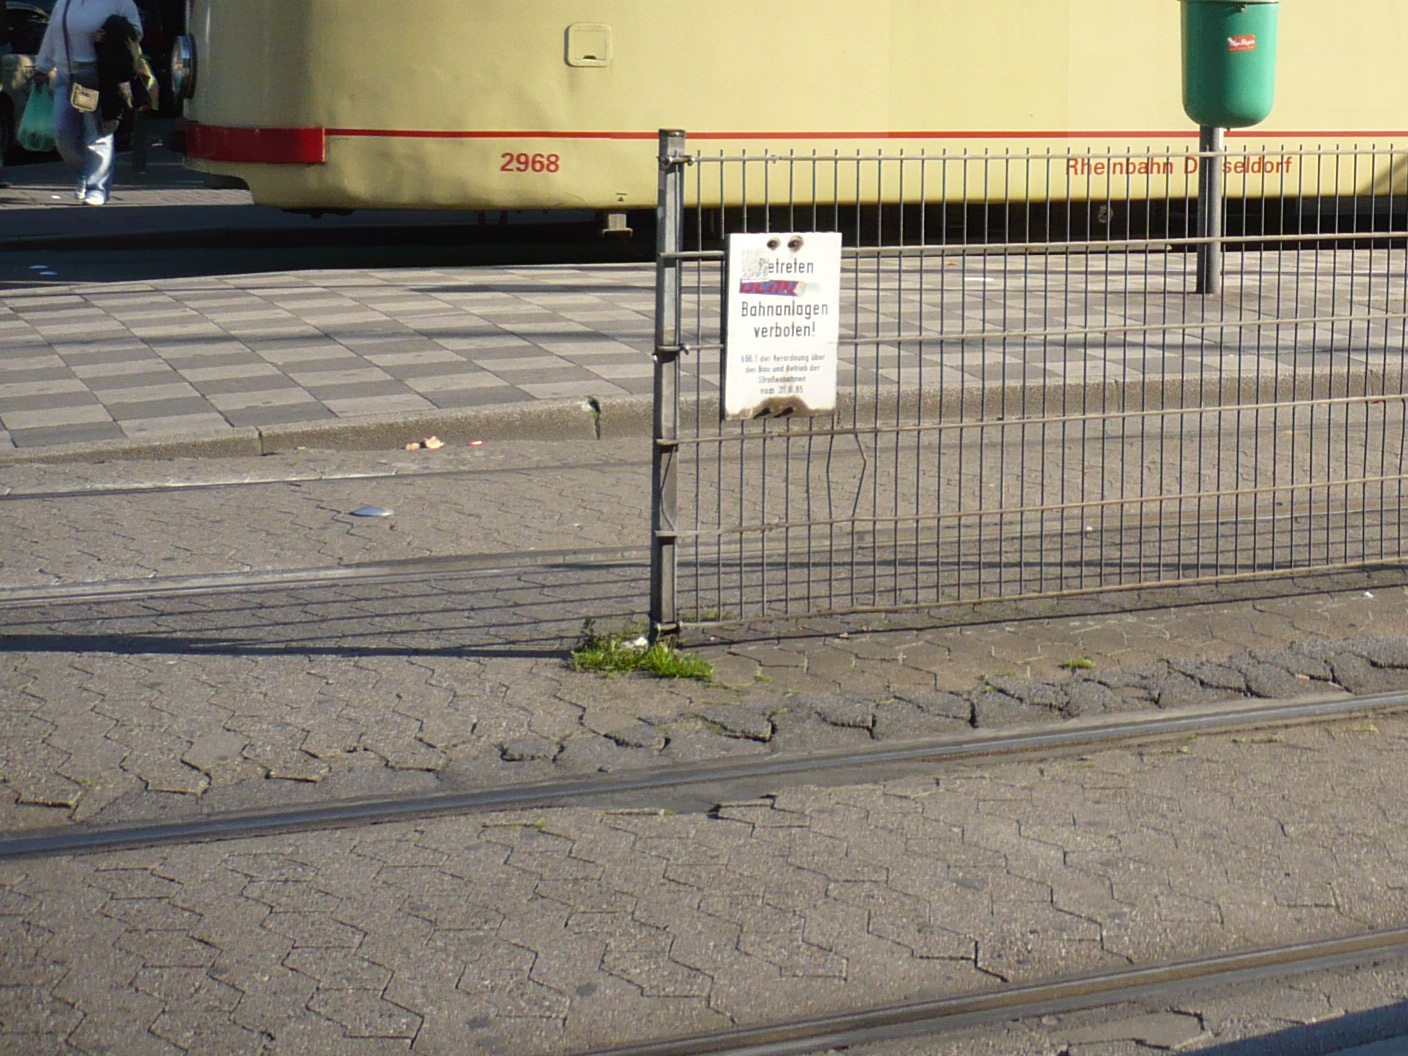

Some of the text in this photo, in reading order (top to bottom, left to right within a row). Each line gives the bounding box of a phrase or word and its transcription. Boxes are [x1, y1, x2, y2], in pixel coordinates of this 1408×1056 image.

[500, 152, 560, 173] 2968
[1183, 155, 1293, 175] Dseldorf
[741, 300, 829, 320] Bahnanlagen
[754, 321, 816, 338] verboten!
